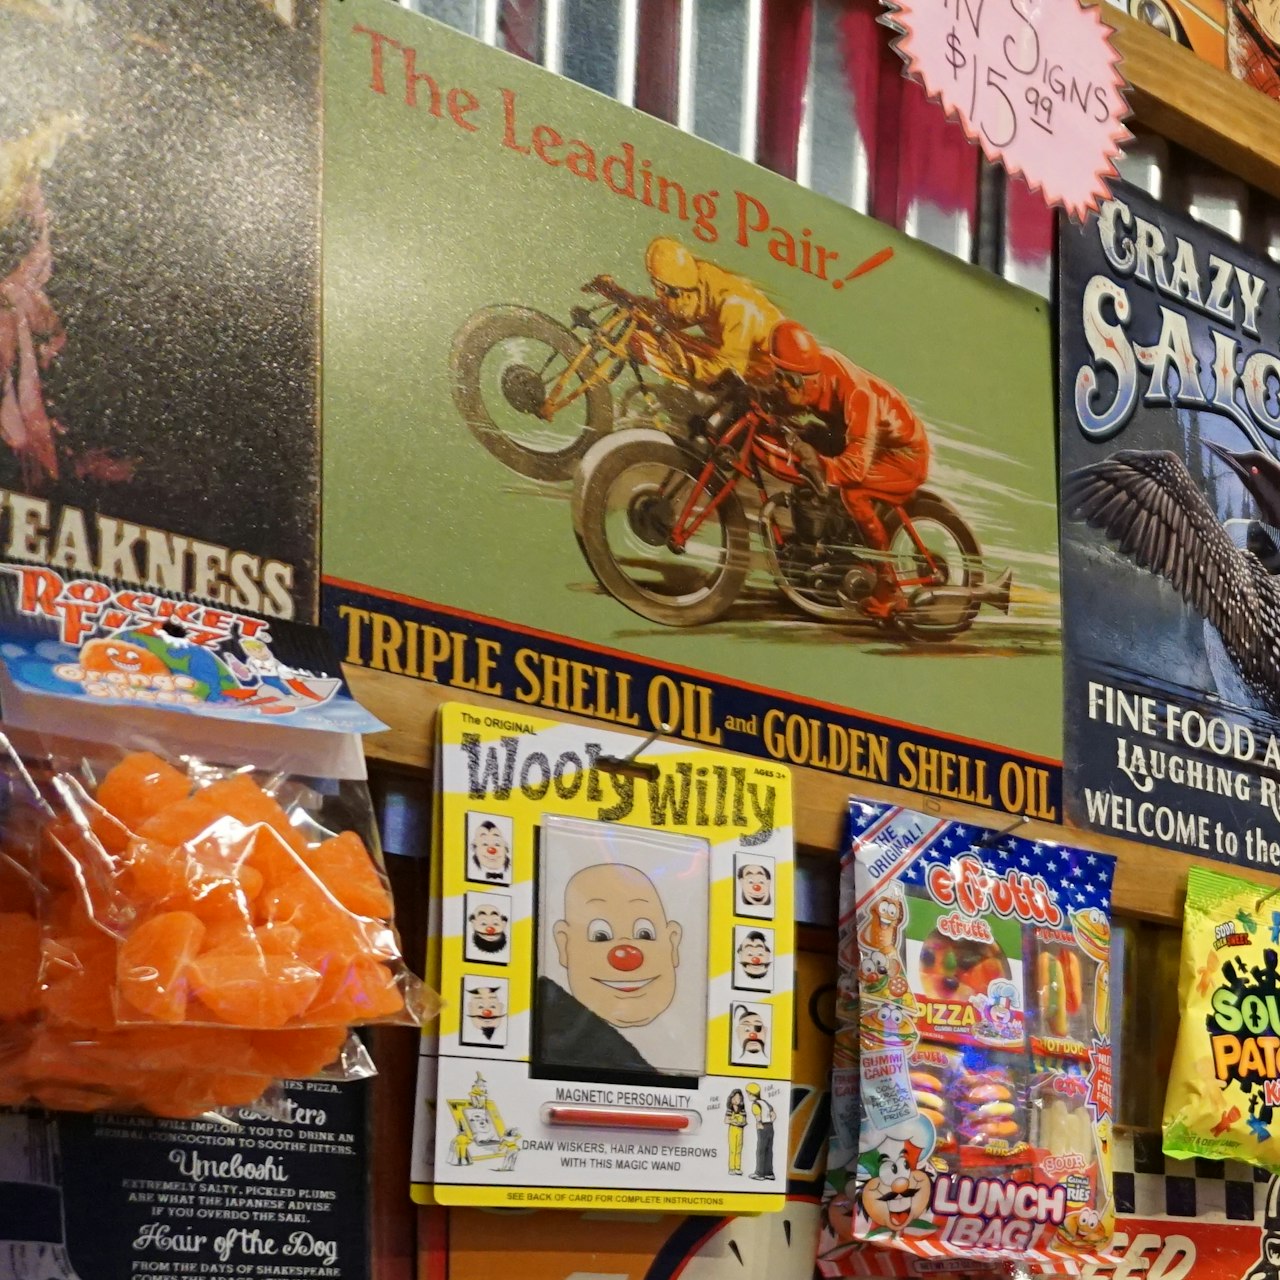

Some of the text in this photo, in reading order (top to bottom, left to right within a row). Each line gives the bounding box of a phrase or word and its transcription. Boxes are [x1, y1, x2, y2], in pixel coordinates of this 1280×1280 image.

[1003, 0, 1110, 124] SIGNS
[353, 24, 895, 291] The Leading Pair!
[1098, 198, 1268, 338] CRAZY
[5, 565, 270, 640] ROCKET
[339, 604, 1056, 823] TRIPLE SHELL OIL and GOLDEN SHELL OIL
[1088, 681, 1157, 736] FINE
[1166, 703, 1256, 763] FOOD
[461, 732, 777, 848] Wooly Willy
[1117, 737, 1251, 802] LAUGHING
[1085, 788, 1210, 851] WELCOME
[1214, 821, 1239, 857] to
[1246, 828, 1280, 867] the
[556, 1087, 691, 1109] MAGNETIC PERSONALITY
[522, 1139, 718, 1159] DRAW WISKERS, HAIR AND EYEBROWS
[931, 1173, 1066, 1223] LUNCH
[133, 1223, 340, 1266] Hair of the Dog
